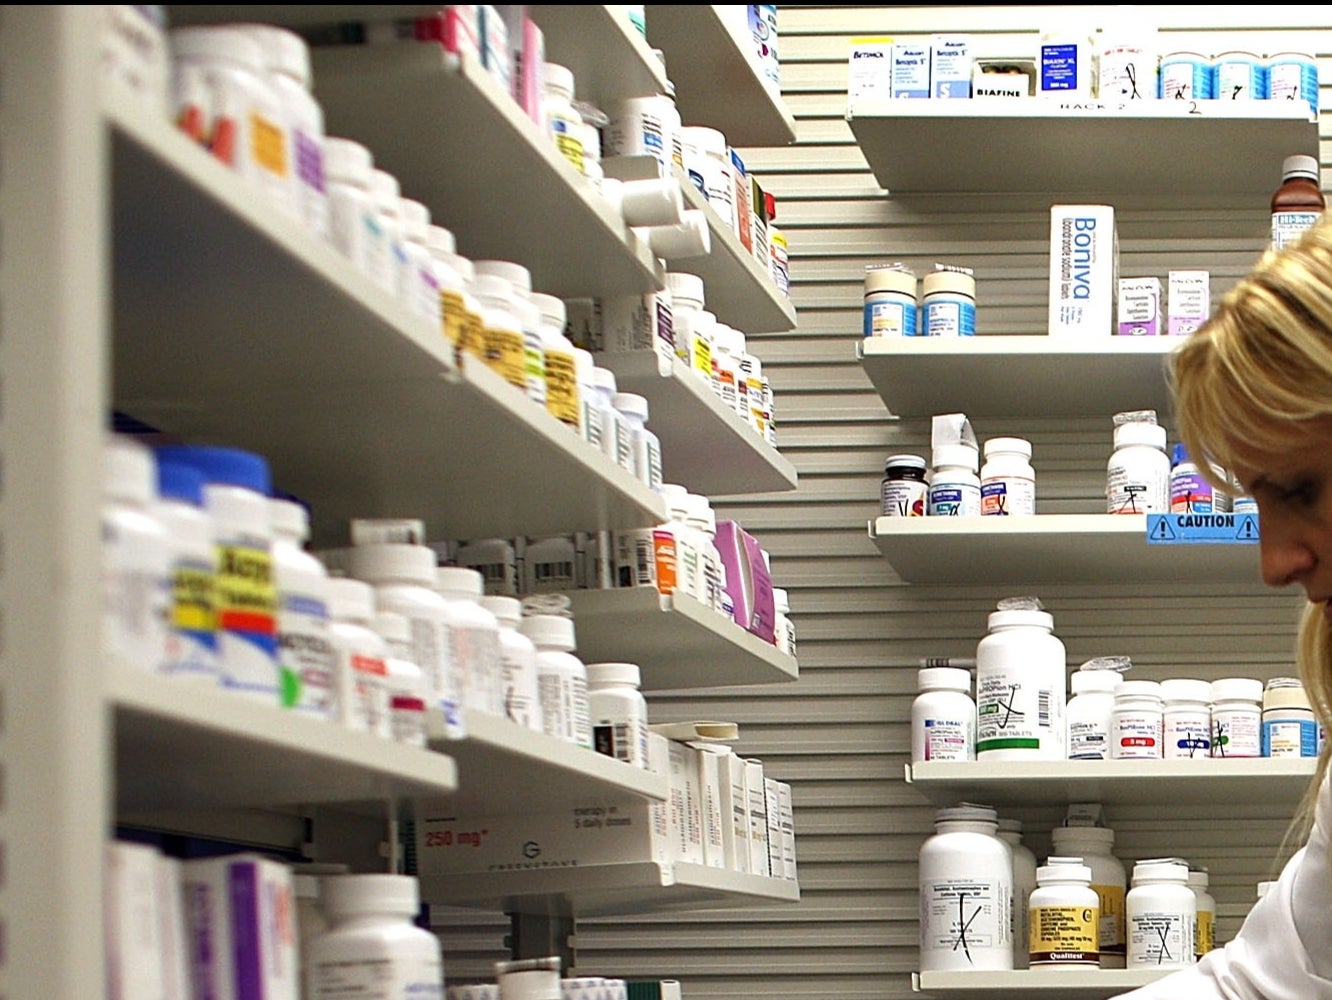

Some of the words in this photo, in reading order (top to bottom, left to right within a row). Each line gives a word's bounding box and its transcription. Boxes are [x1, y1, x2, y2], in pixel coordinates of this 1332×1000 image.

[977, 89, 1021, 97] BIAFINE
[1073, 217, 1097, 299] Boniva
[1178, 515, 1234, 528] CAUTION
[1050, 952, 1081, 961] Qualitest
